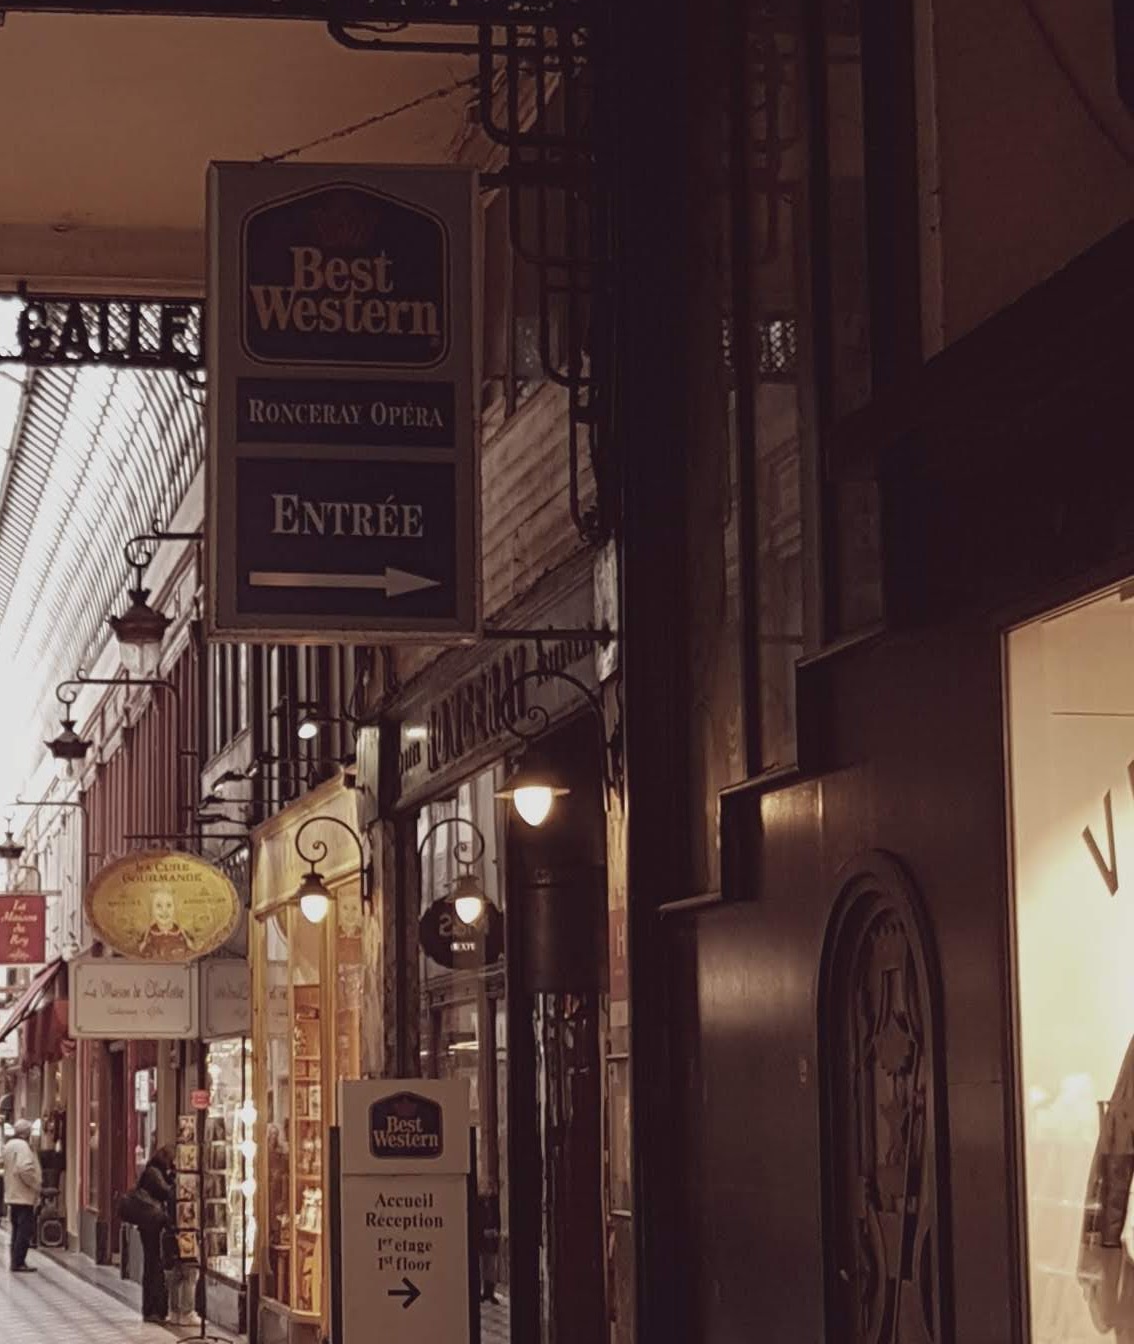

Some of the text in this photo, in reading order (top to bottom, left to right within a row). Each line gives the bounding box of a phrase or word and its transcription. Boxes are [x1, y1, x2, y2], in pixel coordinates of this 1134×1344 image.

[290, 246, 395, 294] Best
[249, 284, 441, 336] Western
[20, 299, 200, 358] GALLE
[248, 398, 445, 428] RONCERAY OPÉRA
[270, 492, 425, 539] ENTRÉE
[121, 871, 202, 883] GOURMANDE
[386, 1114, 424, 1134] Best
[373, 1129, 440, 1149] Western
[375, 1192, 435, 1209] Accueil
[377, 1255, 433, 1272] 1st floor
